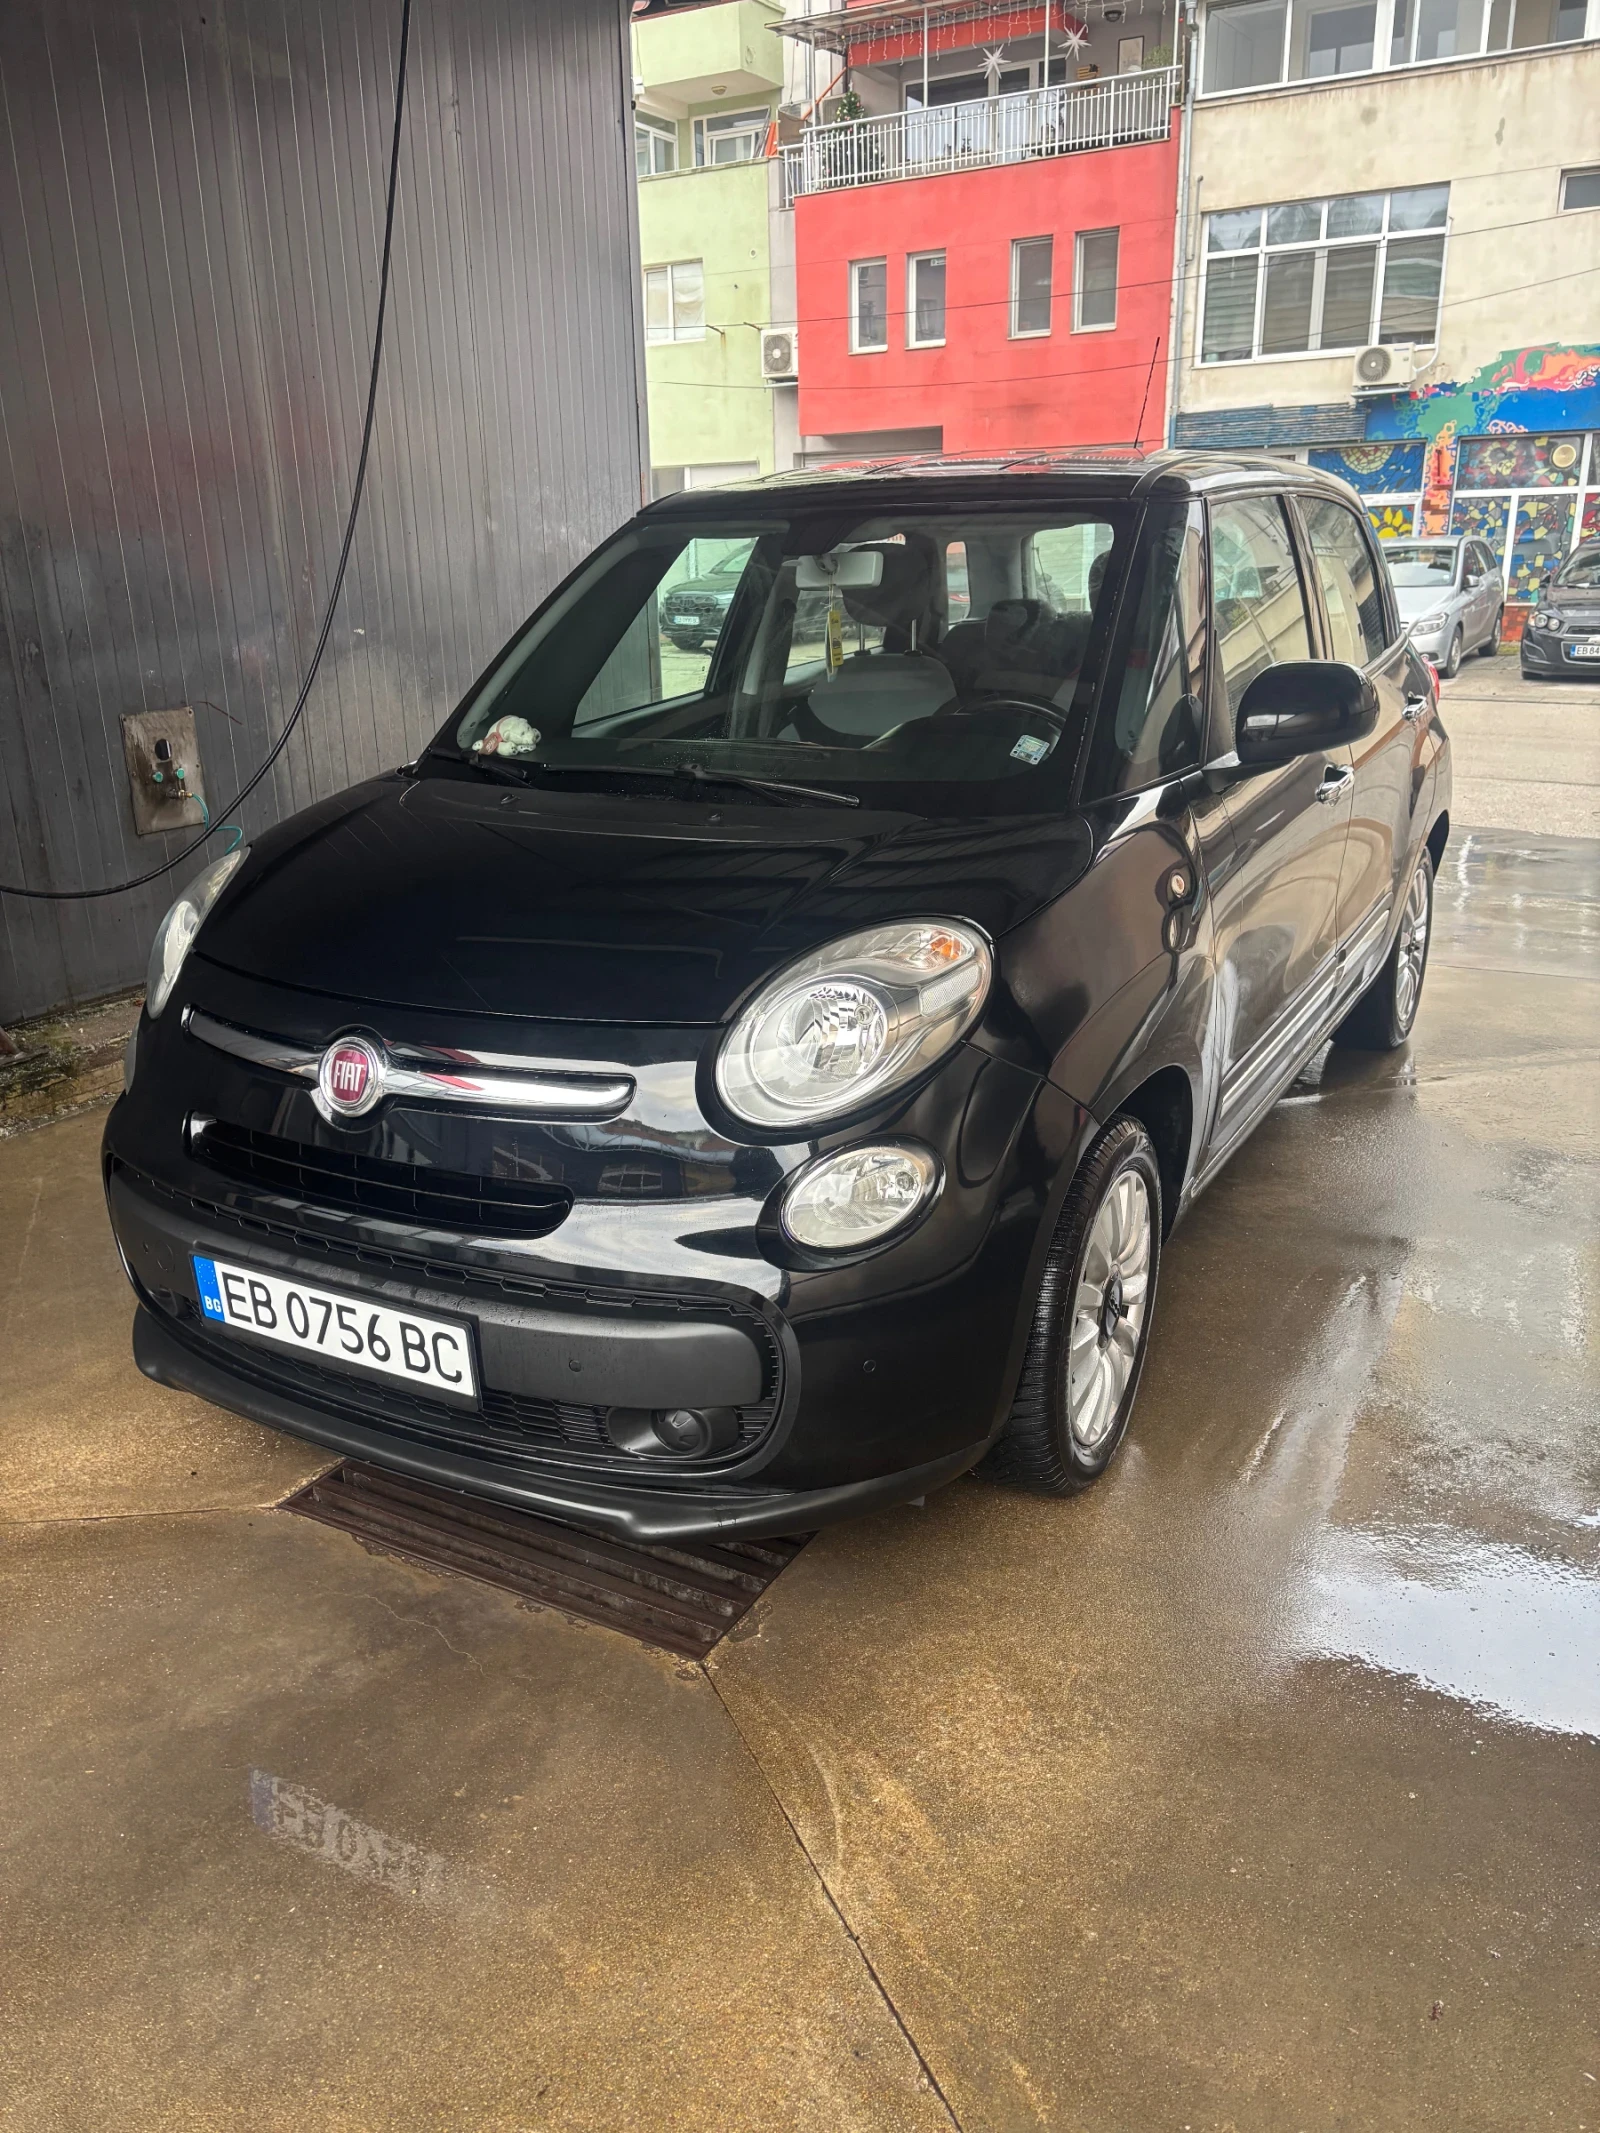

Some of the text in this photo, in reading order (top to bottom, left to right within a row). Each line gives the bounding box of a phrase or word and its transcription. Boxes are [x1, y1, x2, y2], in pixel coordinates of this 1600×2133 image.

[333, 1060, 365, 1092] FIAT
[204, 1295, 222, 1313] BG
[222, 1271, 462, 1383] EB 0756 BC
